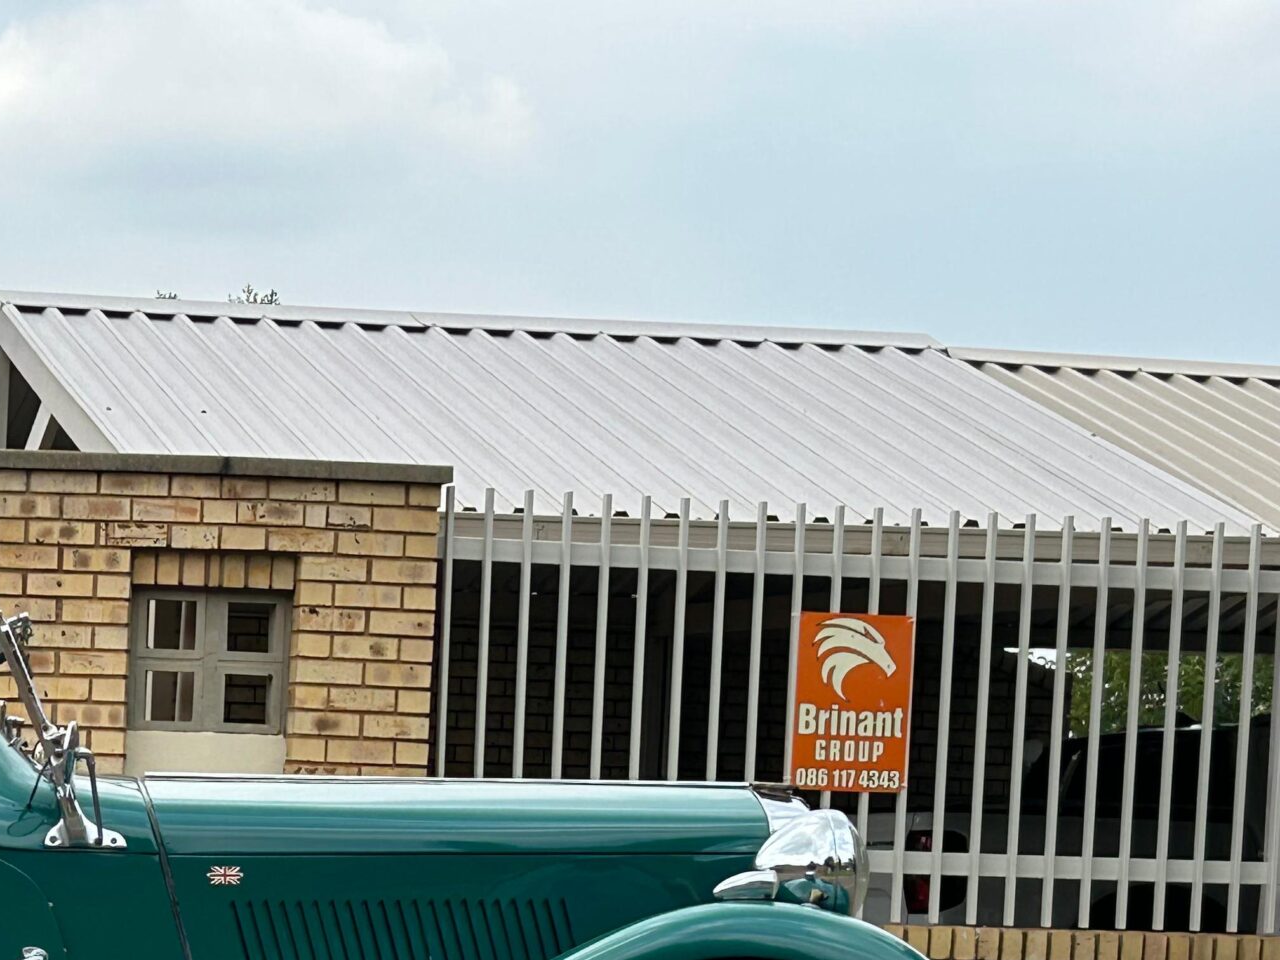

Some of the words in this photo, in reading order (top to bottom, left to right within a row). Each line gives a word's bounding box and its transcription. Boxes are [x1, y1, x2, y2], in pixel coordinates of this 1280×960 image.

[798, 703, 903, 738] Brinant
[815, 740, 884, 762] GROUP
[796, 768, 828, 786] 086
[832, 769, 856, 788] 117
[858, 770, 900, 789] 4343
